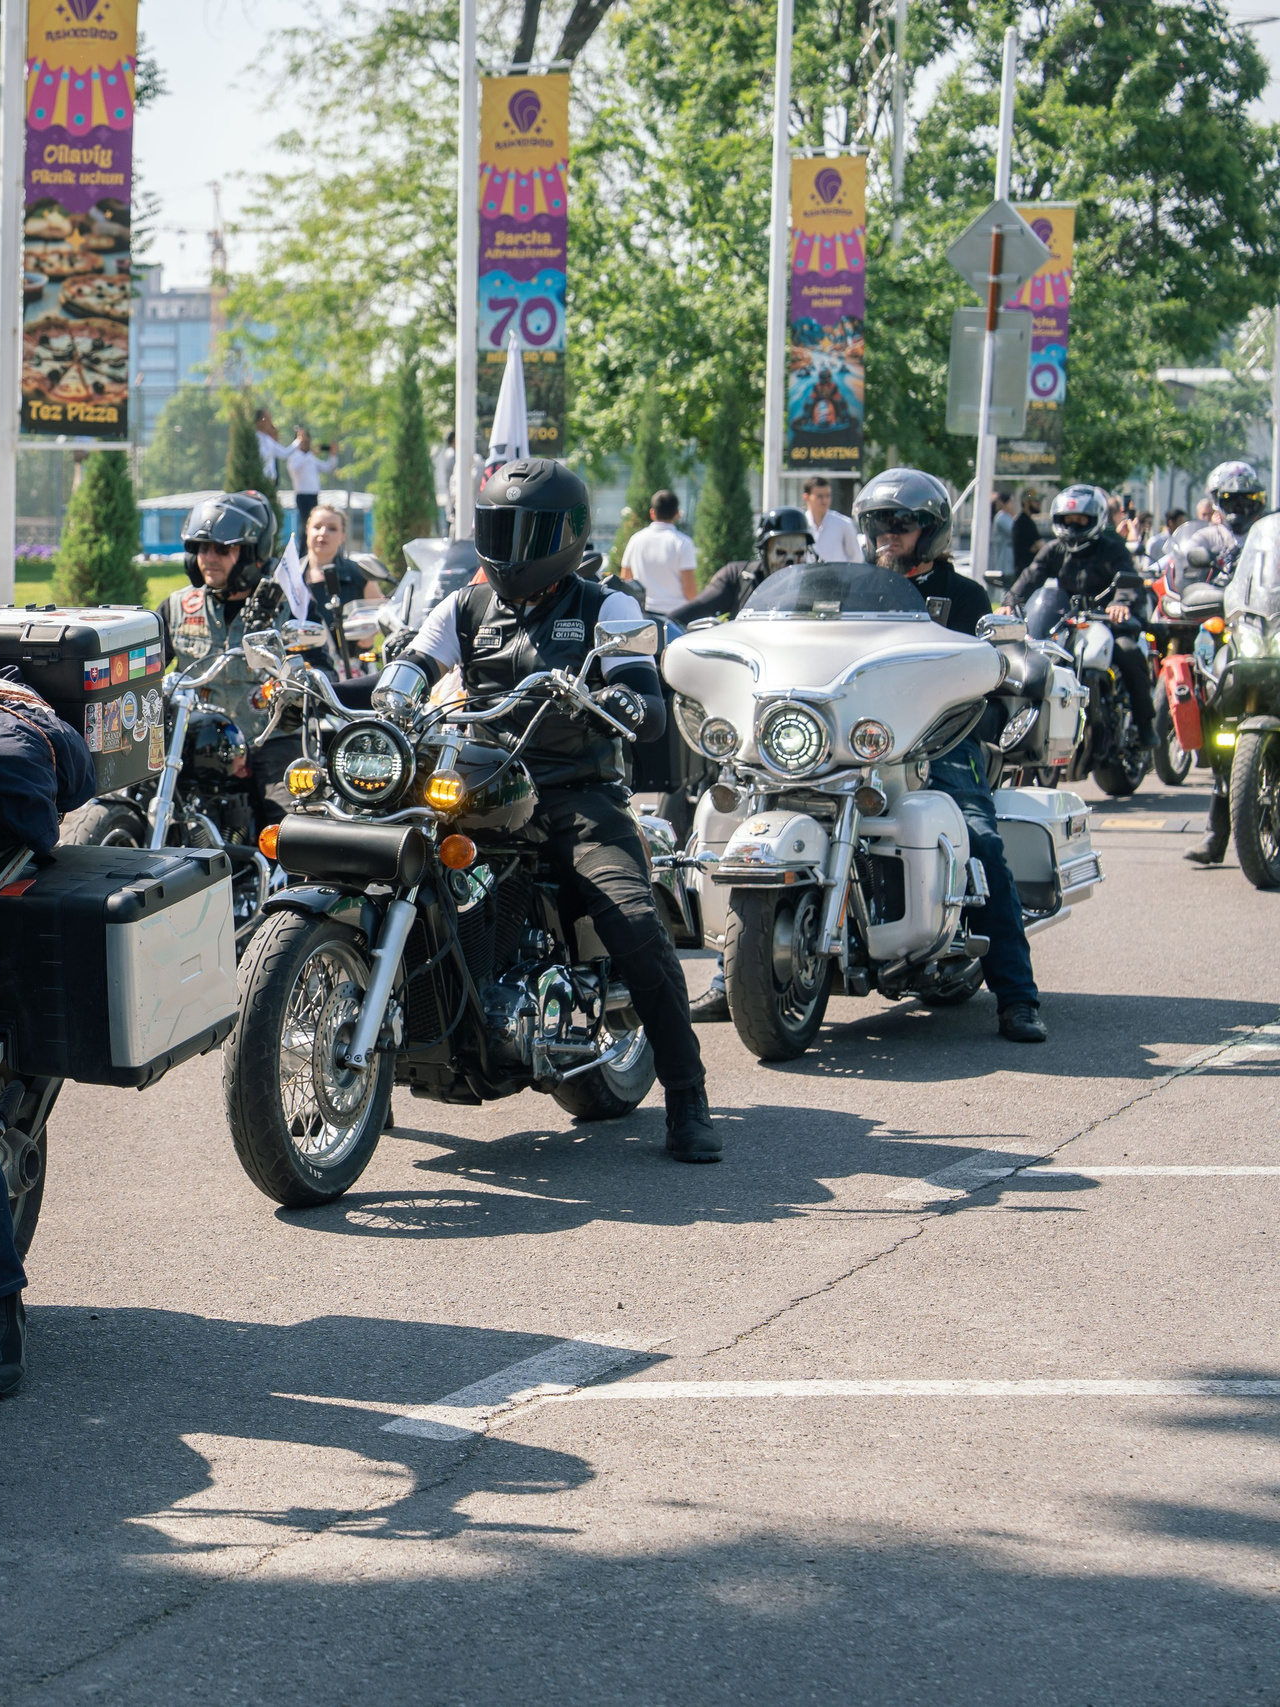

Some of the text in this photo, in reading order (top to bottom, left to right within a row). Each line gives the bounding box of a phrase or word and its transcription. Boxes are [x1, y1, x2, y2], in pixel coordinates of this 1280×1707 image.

[31, 169, 76, 184] Piknik
[494, 230, 552, 246] Barcha
[487, 296, 557, 346] 70
[1030, 363, 1058, 397] 0
[28, 400, 119, 423] Tez Pizza
[791, 446, 859, 460] GO KARTING
